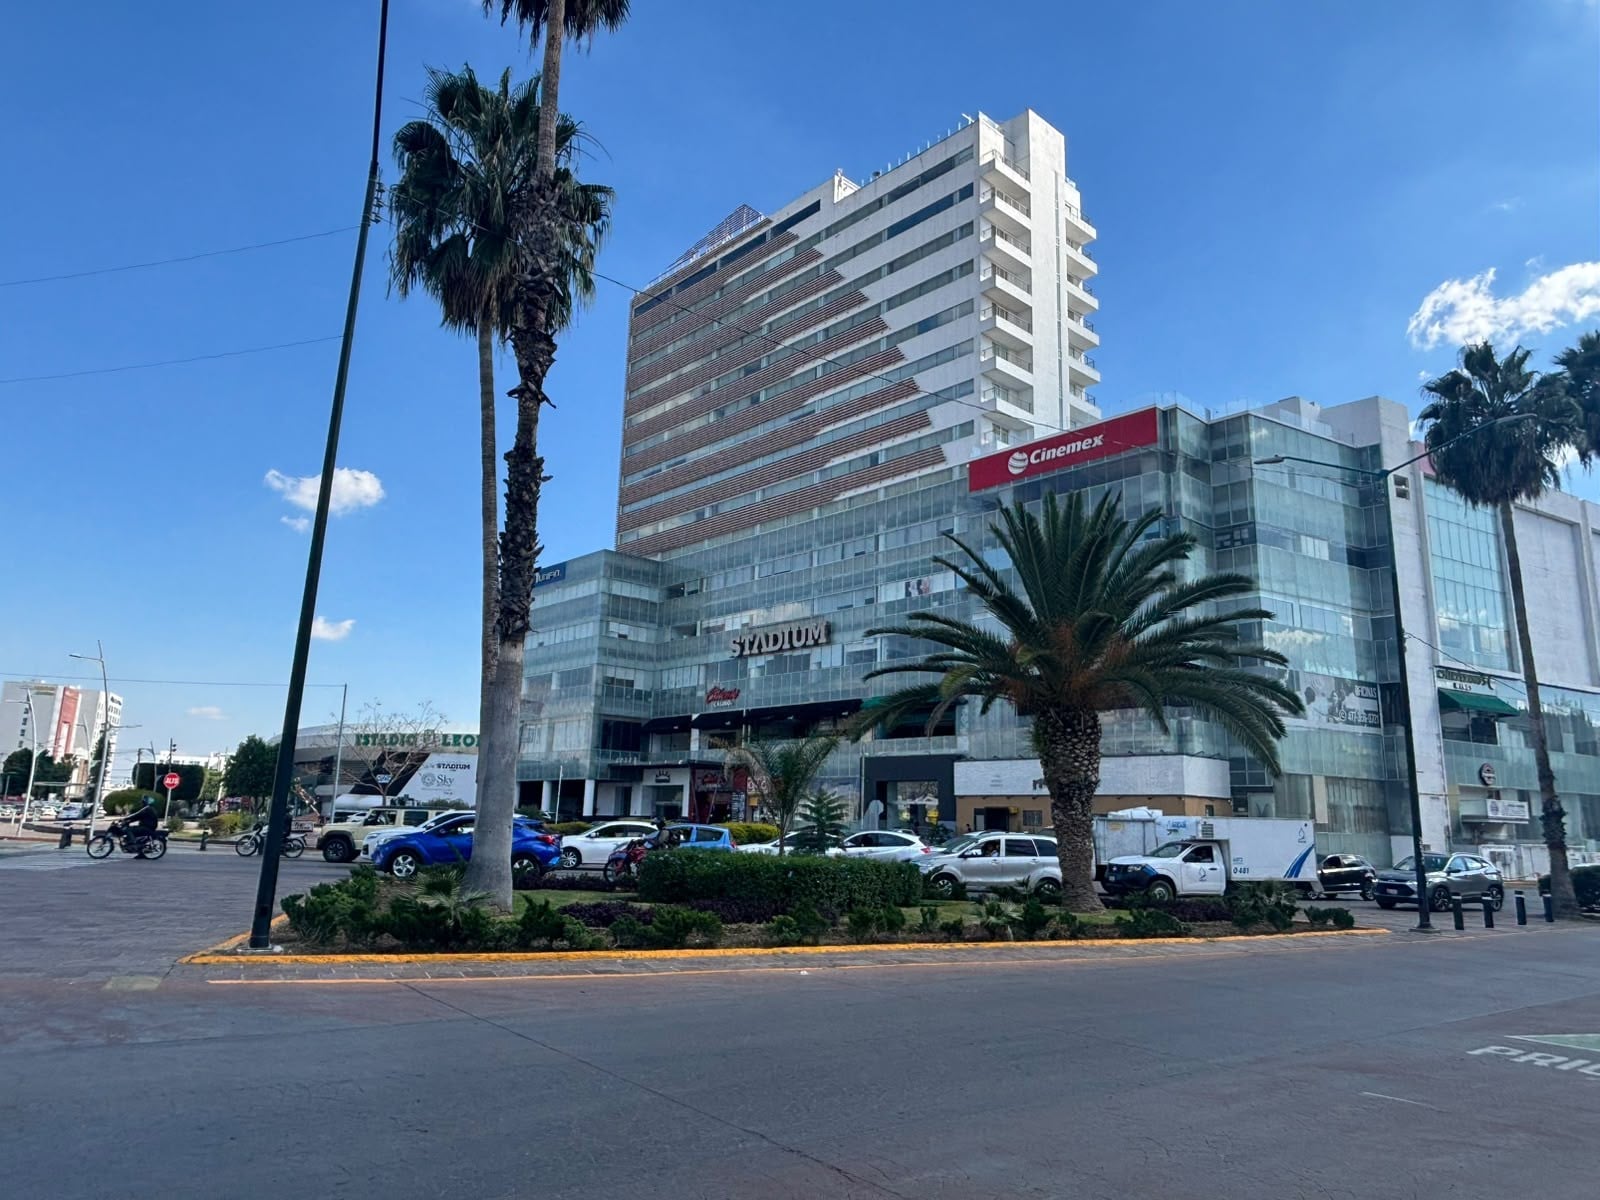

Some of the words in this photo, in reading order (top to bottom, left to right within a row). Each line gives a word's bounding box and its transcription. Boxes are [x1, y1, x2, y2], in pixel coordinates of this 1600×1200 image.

[1030, 434, 1104, 465] Cinemex
[730, 621, 829, 658] STADIUM
[354, 733, 418, 747] ESTADIO
[436, 773, 455, 787] Sky
